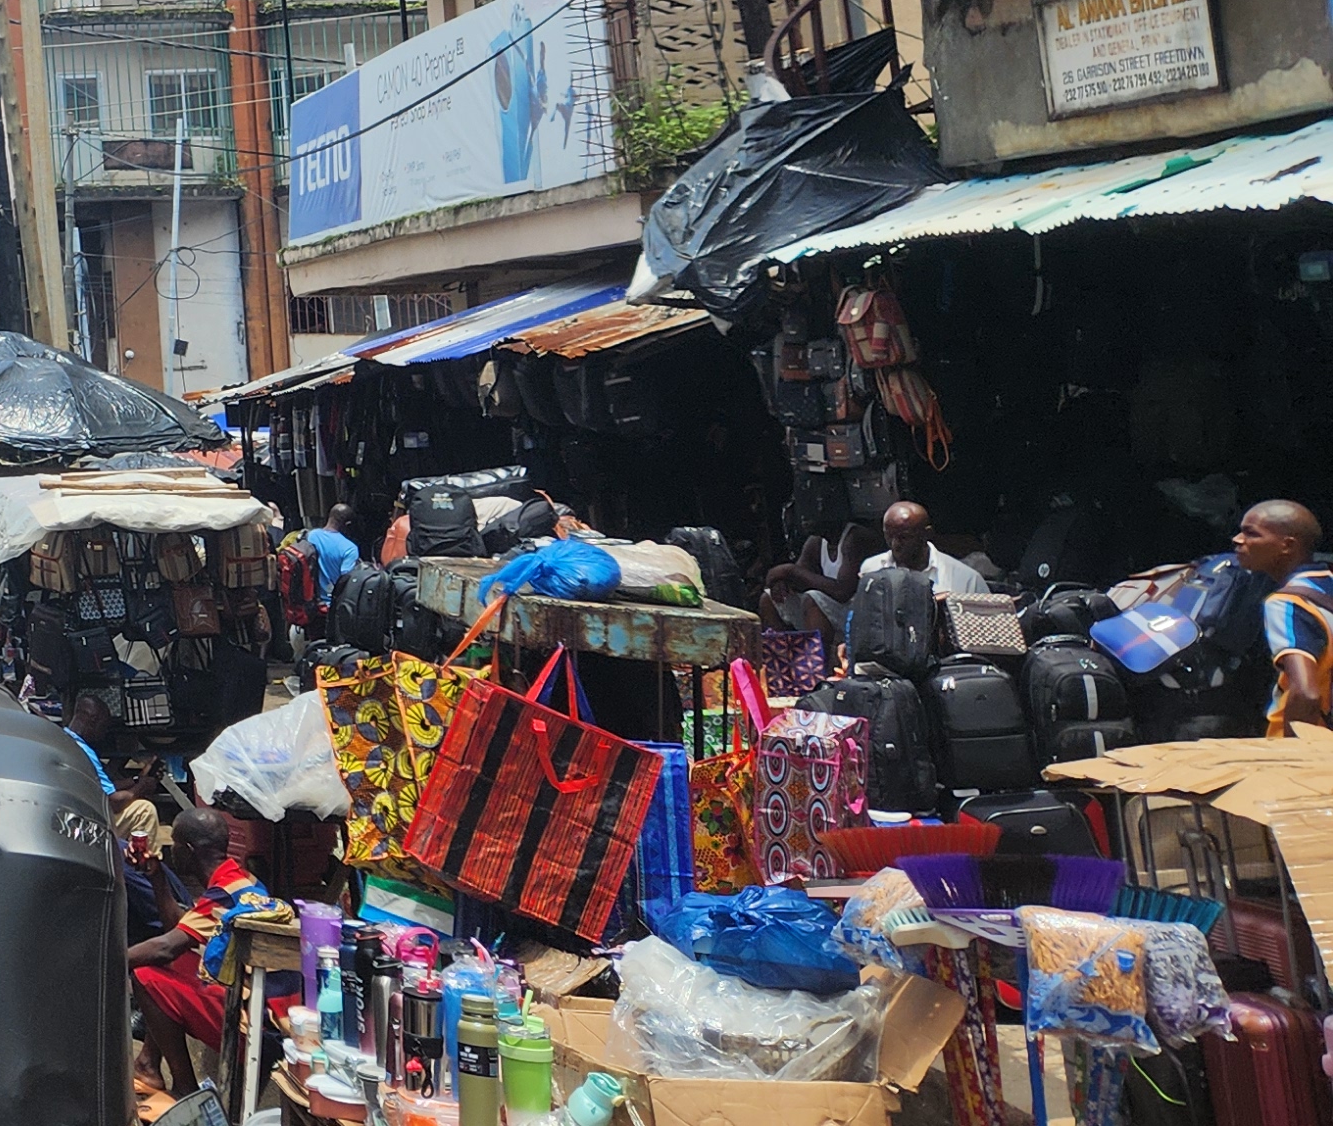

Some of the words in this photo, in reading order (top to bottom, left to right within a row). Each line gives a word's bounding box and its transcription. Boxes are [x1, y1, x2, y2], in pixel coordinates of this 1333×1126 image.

[376, 66, 408, 104] CAMON
[411, 56, 422, 87] 40
[425, 45, 455, 85] Premier
[1118, 53, 1151, 73] STREET
[1154, 46, 1205, 66] FREETOWN
[427, 96, 452, 120] Anytime
[296, 124, 352, 196] TECNO
